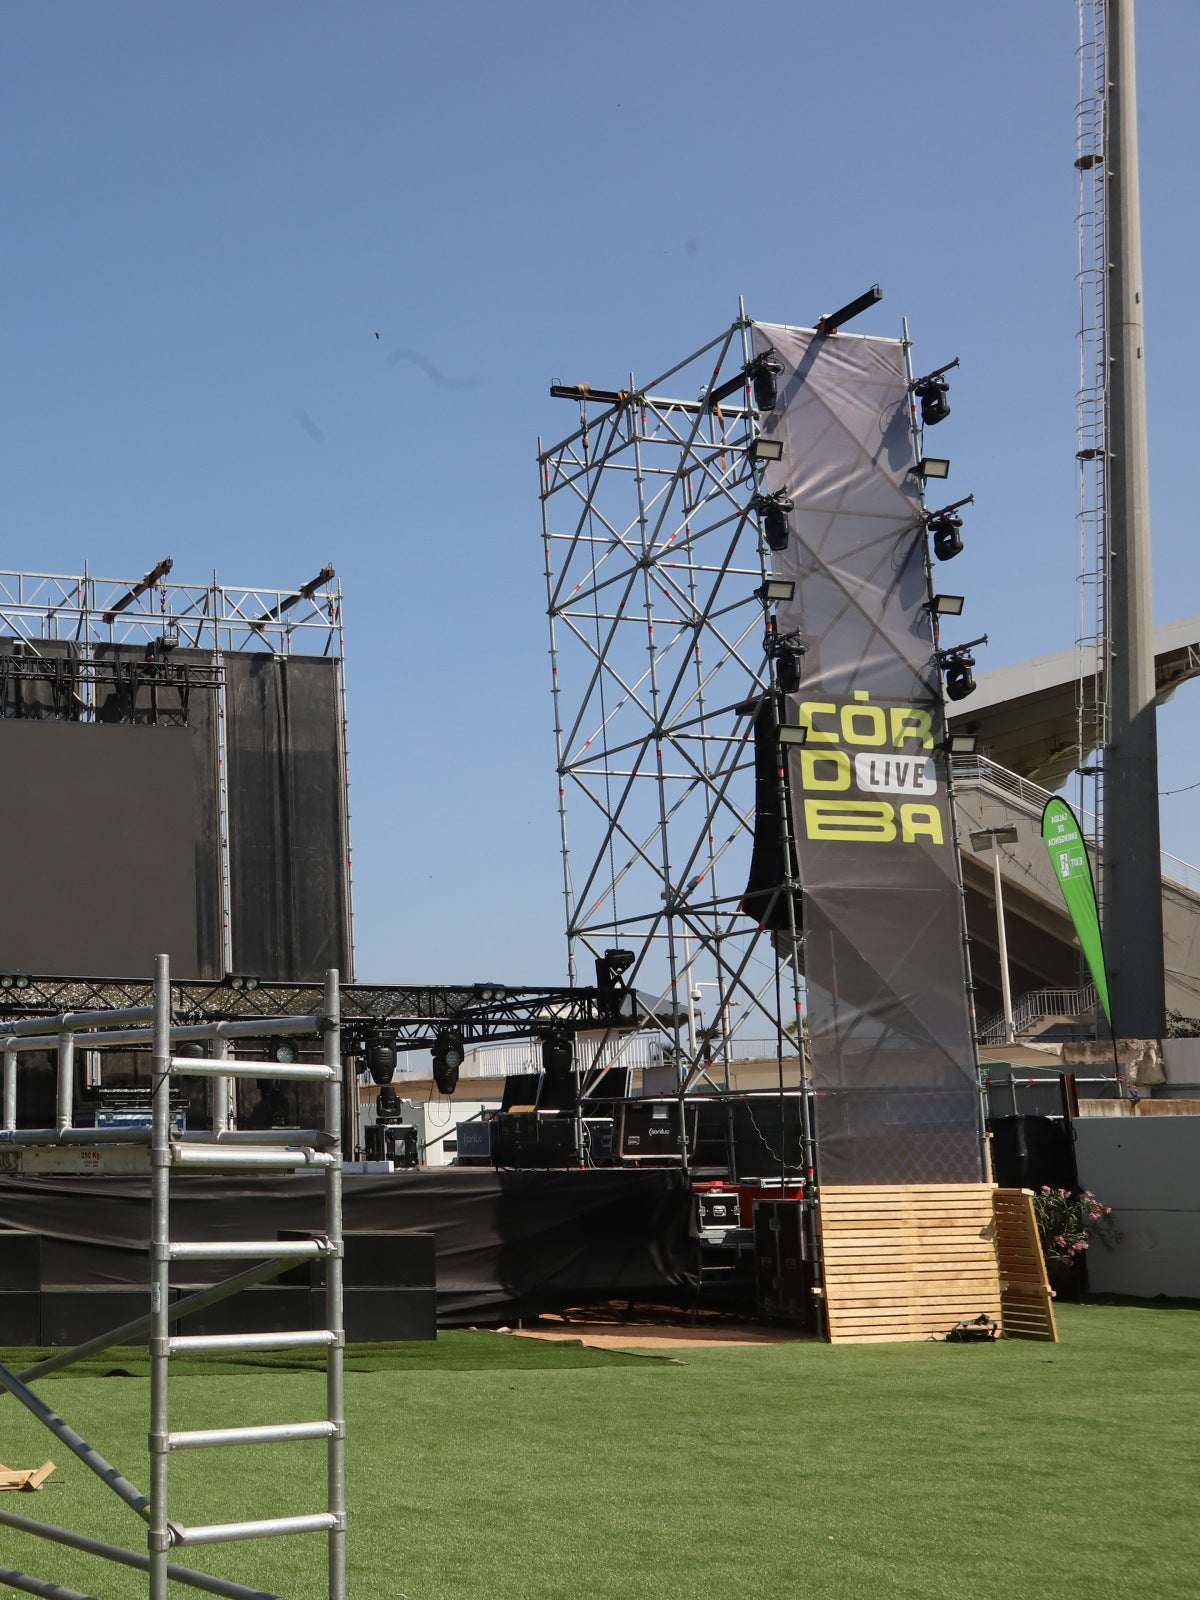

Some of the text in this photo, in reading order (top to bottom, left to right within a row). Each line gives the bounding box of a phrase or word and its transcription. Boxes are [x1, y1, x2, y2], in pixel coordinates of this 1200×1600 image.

[800, 750, 925, 791] D LIVE
[804, 799, 944, 845] BA
[80, 1151, 92, 1159] 250
